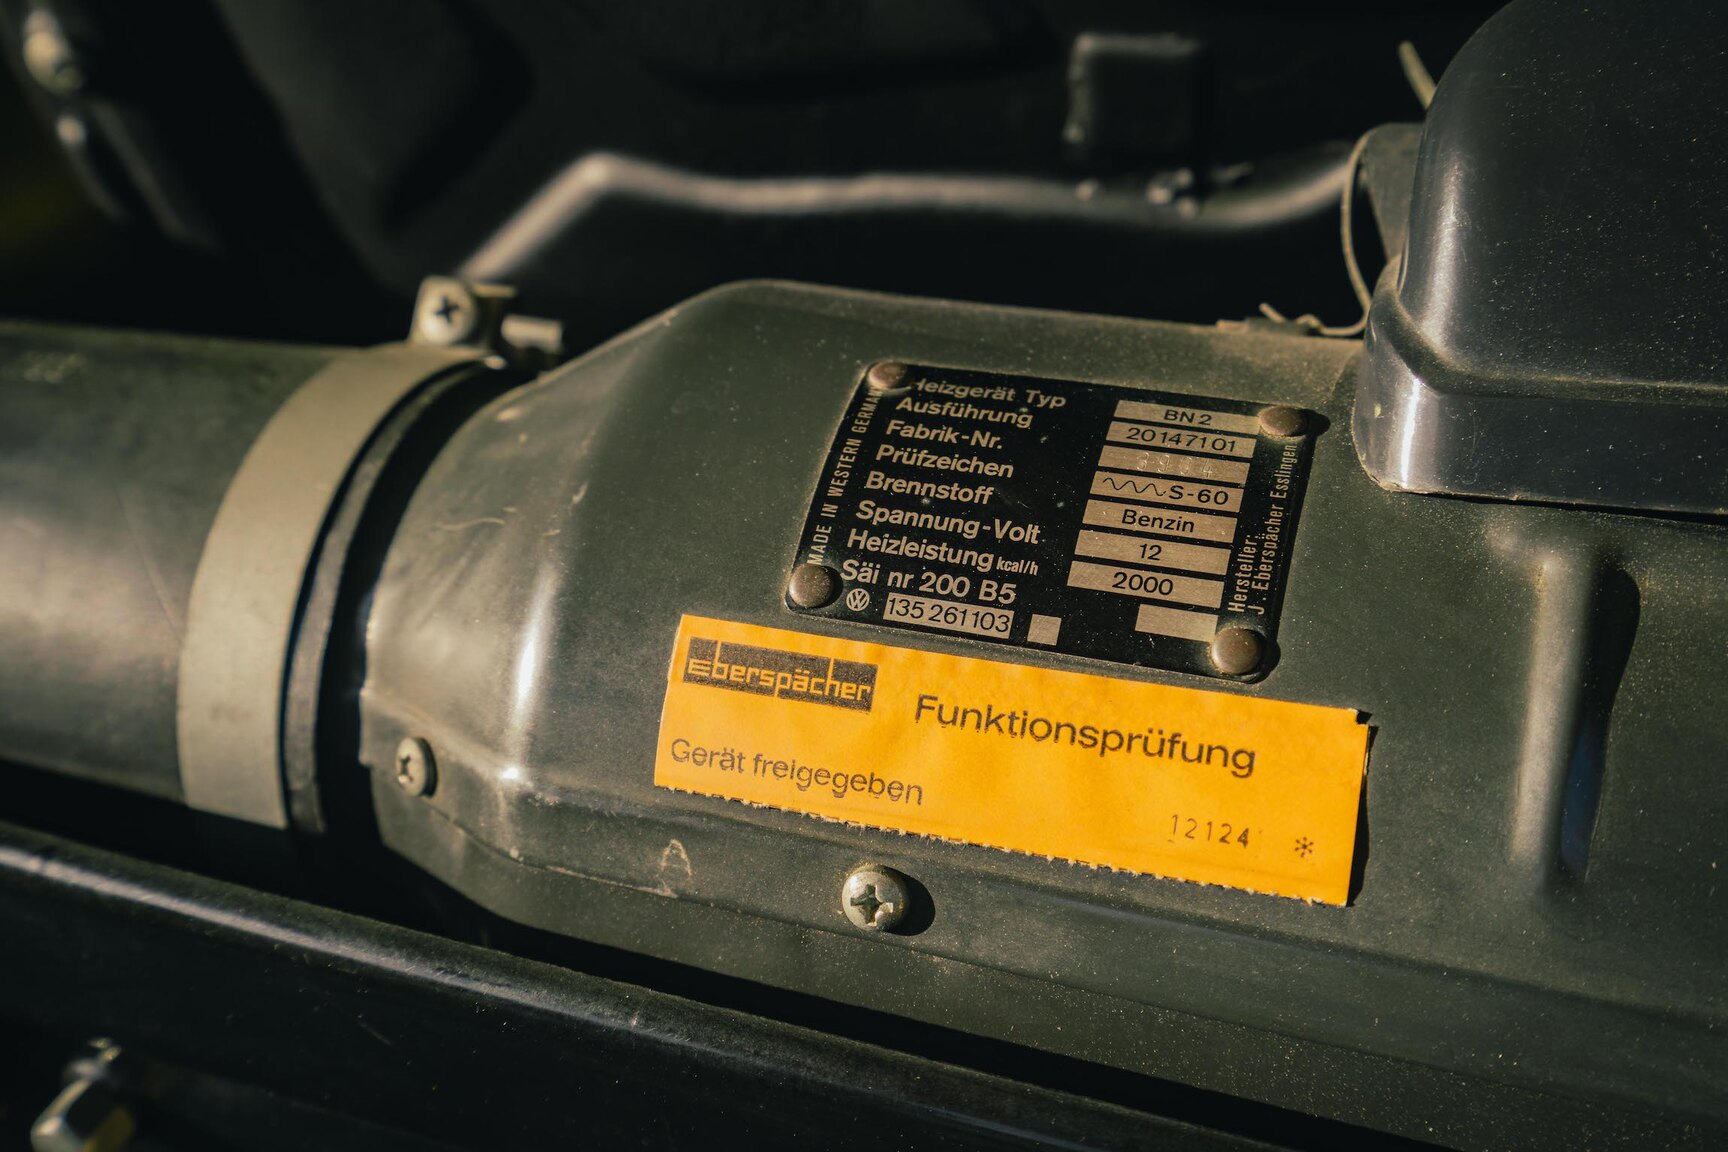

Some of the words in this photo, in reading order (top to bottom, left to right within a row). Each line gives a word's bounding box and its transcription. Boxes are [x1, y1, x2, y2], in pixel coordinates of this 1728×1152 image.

[851, 386, 884, 434] GERMAN
[896, 396, 1034, 429] Ausführung
[1026, 388, 1067, 410] Typ
[885, 419, 1003, 450] Fabrik-Nr.
[1125, 427, 1237, 453] 20147101
[827, 438, 862, 498] WESTERN
[875, 443, 1015, 478] Prüfzeichen
[865, 470, 995, 505] Brennstoff
[820, 502, 839, 519] IN
[855, 499, 1042, 546] Spannung-Volt
[1121, 508, 1195, 534] Benzin
[1252, 502, 1285, 591] Eberspächer
[1269, 444, 1298, 500] Esslingen
[806, 524, 833, 566] MADE
[846, 528, 995, 573] Heizleistung
[996, 556, 1040, 577] kcal/h
[1139, 543, 1163, 562] 12
[840, 558, 881, 585] Säi
[886, 570, 914, 589] nr
[918, 571, 971, 599] 200
[978, 579, 1017, 605] B5
[1111, 571, 1174, 596] 2000
[686, 640, 872, 702] Eberspächer
[914, 694, 1257, 779] Funktionsprüfung
[670, 738, 746, 774] Gerät
[753, 752, 924, 806] freigegeben
[1171, 813, 1250, 849] 12124
